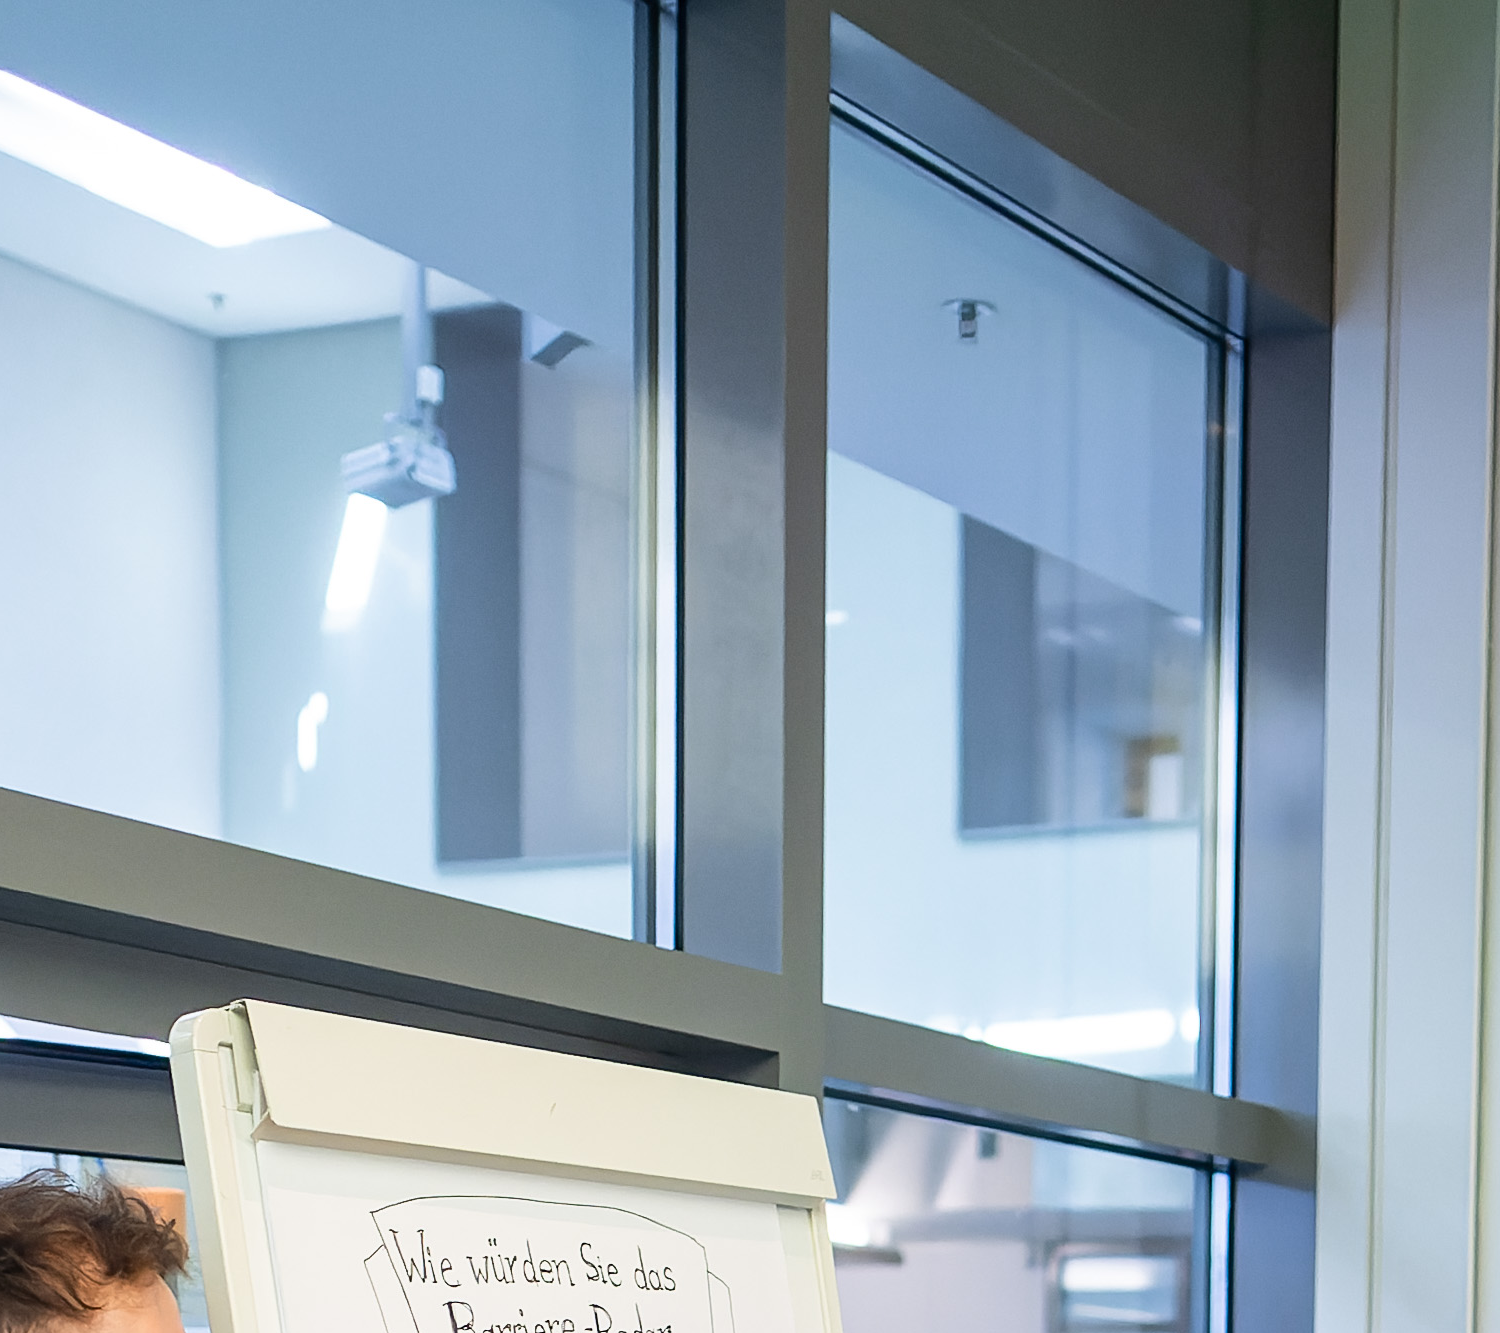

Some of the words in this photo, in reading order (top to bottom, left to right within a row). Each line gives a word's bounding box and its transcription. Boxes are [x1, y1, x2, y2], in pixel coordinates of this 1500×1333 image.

[389, 1228, 462, 1288] Wie
[466, 1237, 575, 1288] würden
[580, 1241, 623, 1287] Sie
[634, 1246, 678, 1293] das
